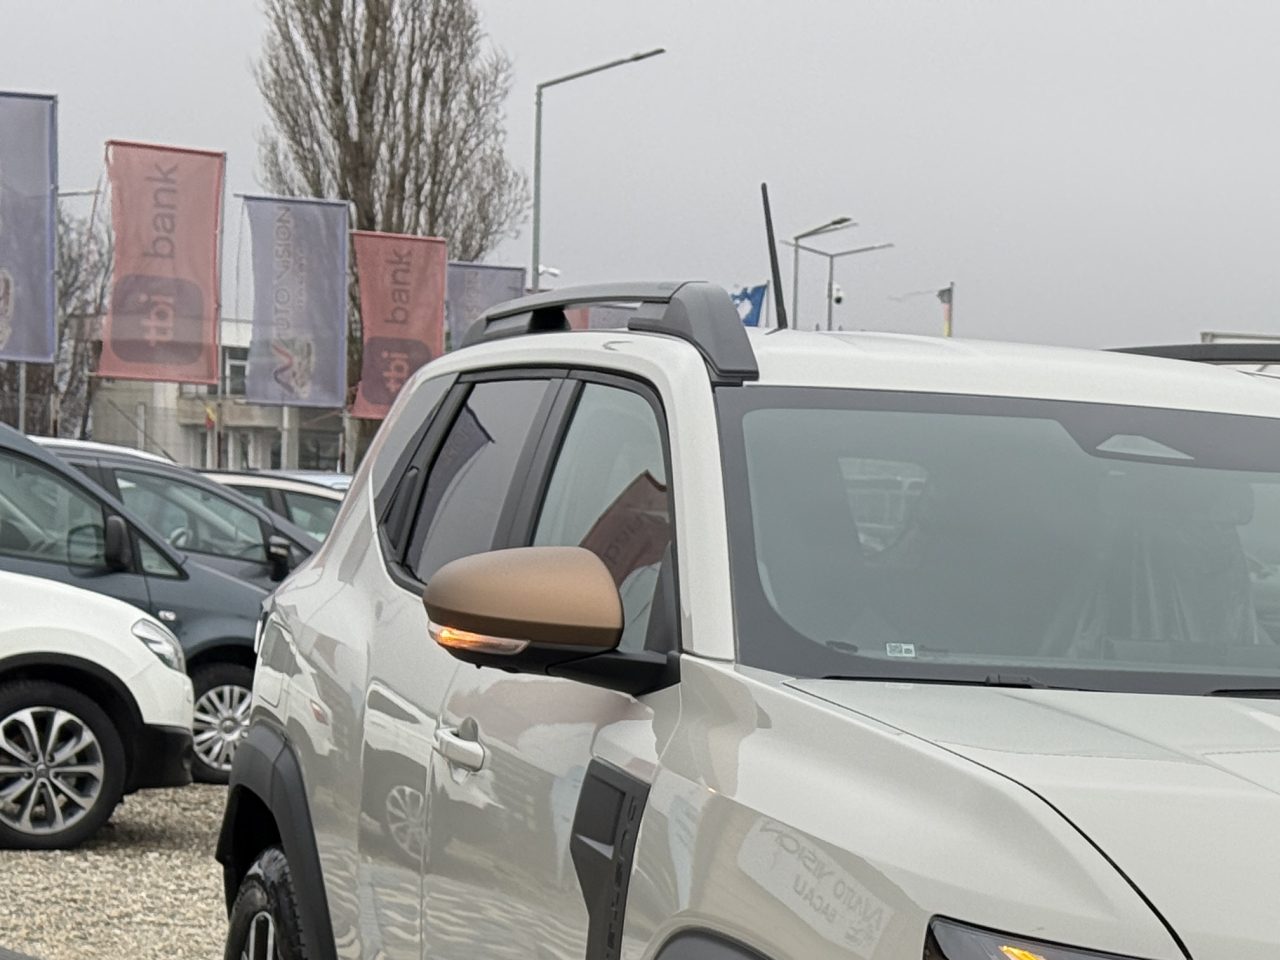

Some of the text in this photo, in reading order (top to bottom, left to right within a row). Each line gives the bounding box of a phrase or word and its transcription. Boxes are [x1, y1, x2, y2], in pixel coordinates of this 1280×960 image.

[137, 163, 179, 347] tbi bank
[384, 249, 414, 326] bank
